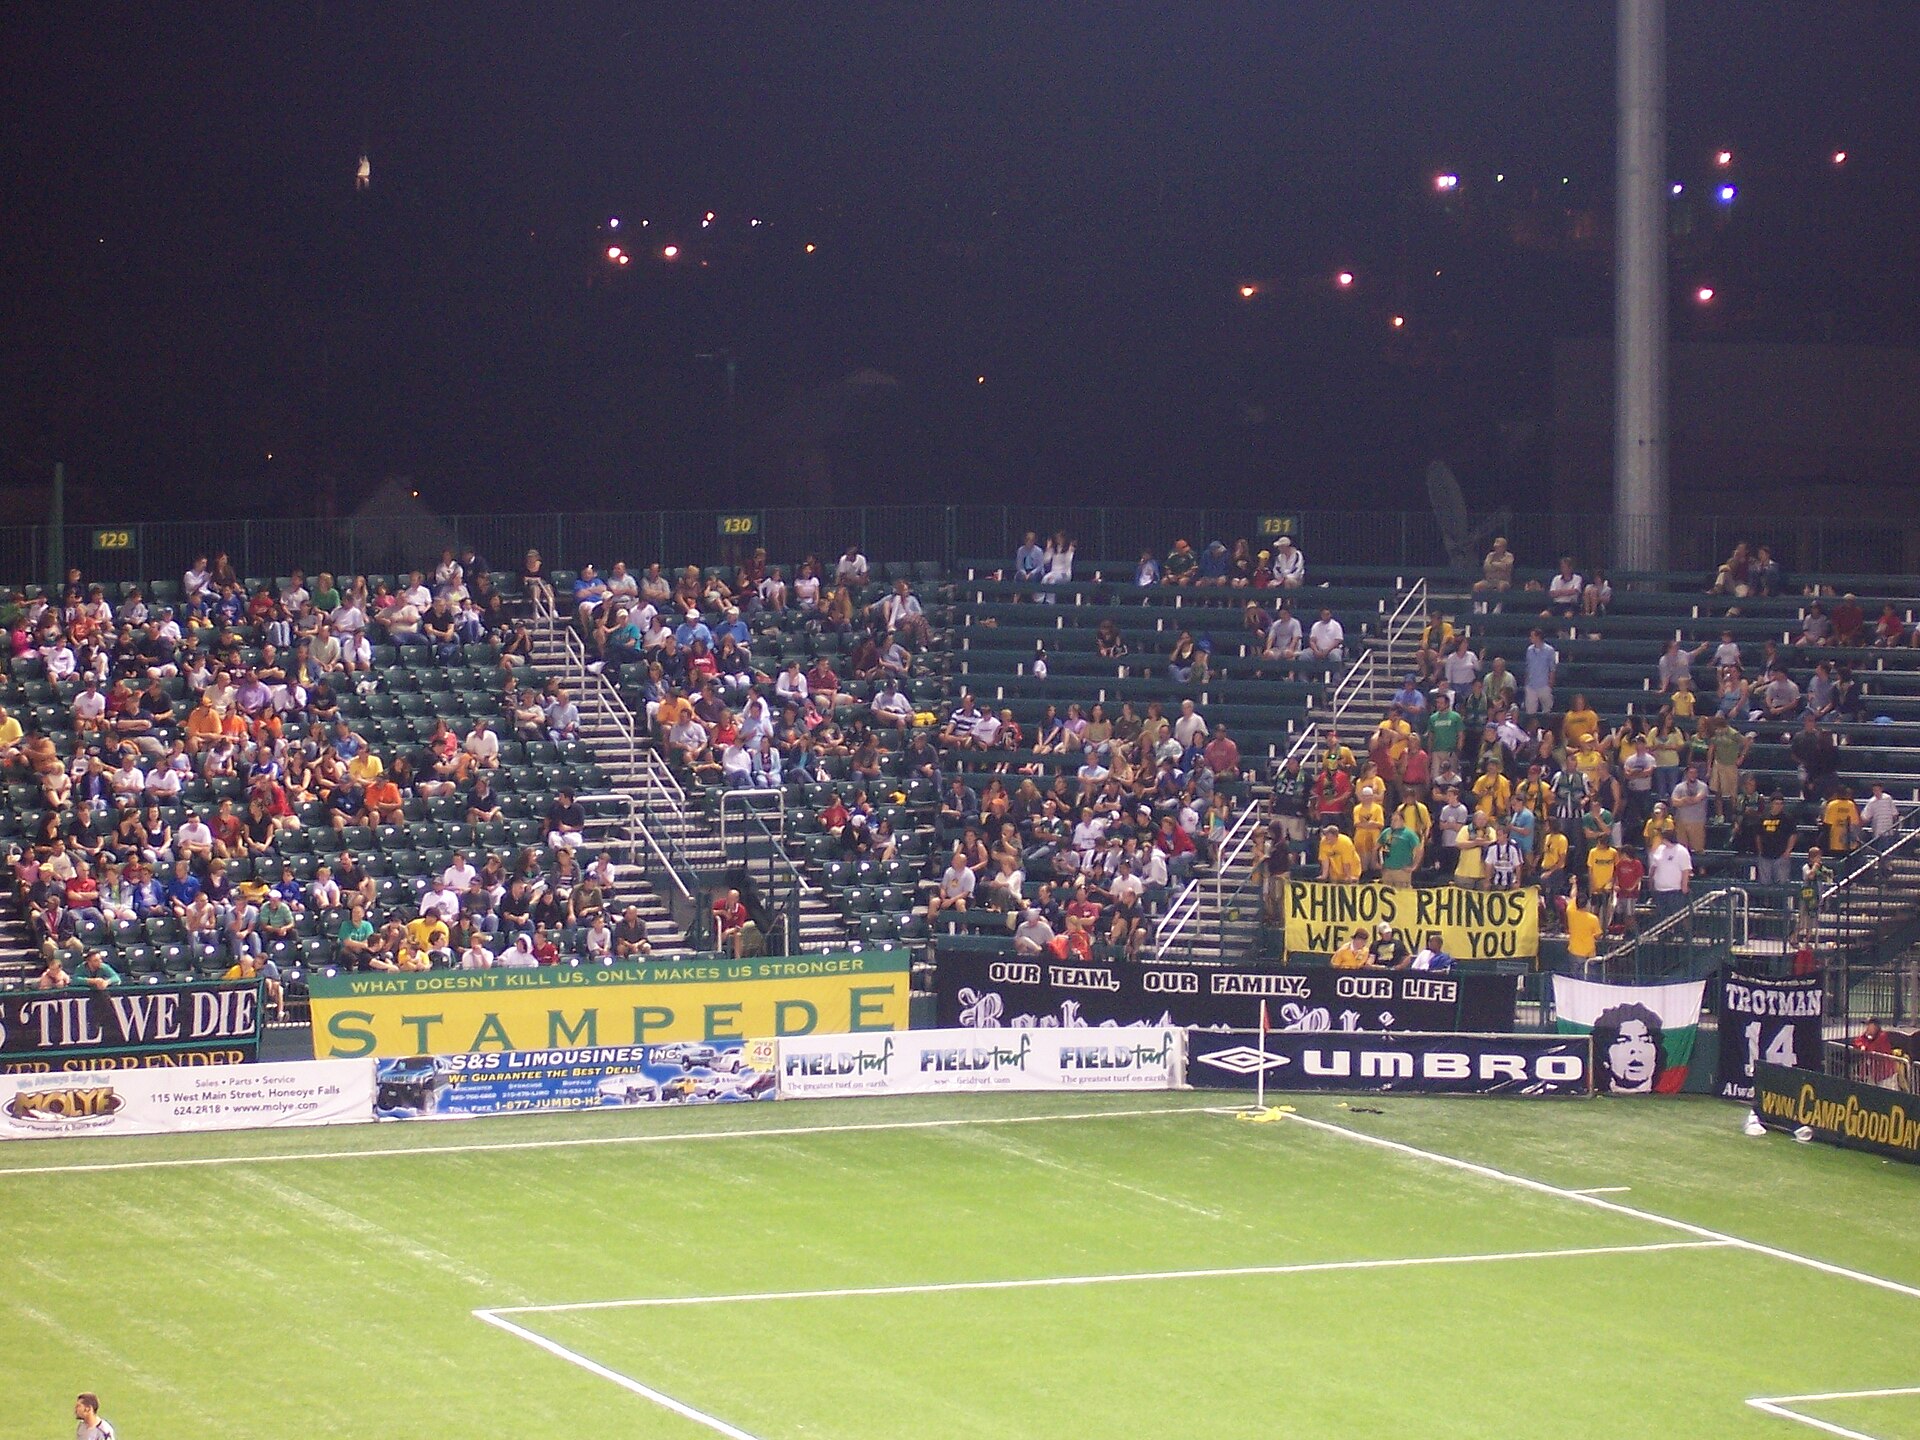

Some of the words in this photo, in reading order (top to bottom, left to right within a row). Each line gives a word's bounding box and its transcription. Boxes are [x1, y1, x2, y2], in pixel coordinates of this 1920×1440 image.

[723, 518, 753, 533] 130
[1264, 519, 1291, 533] 131
[98, 532, 129, 548] 129
[1290, 883, 1397, 922] RHINOS
[1416, 887, 1526, 927] RHINOS
[1306, 924, 1349, 952] WE
[1466, 929, 1517, 958] YOU
[351, 980, 408, 993] WHAT
[415, 974, 498, 990] DOESN'T
[506, 972, 551, 986] KILL
[557, 971, 590, 985] US,
[596, 969, 647, 982] ONLY
[654, 967, 719, 980] MAKES
[728, 965, 752, 978] US
[760, 959, 864, 976] STRONGER
[989, 962, 1041, 984] OUR
[1049, 965, 1121, 992] TEAM,
[1143, 972, 1199, 993] OUR
[1211, 973, 1311, 999] FAMILY,
[1337, 976, 1393, 999] OUR
[1402, 979, 1458, 1002] LIFE
[1726, 983, 1822, 1016] TROTMAN
[110, 993, 182, 1043] WE
[190, 988, 259, 1038] DIE
[327, 984, 895, 1058] STAMPEDE
[451, 1053, 500, 1070] S&S
[509, 1047, 644, 1068] LIMOUSINES
[753, 1046, 772, 1056] 40
[1744, 1021, 1797, 1077] 14
[448, 1074, 468, 1083] WE
[471, 1070, 542, 1082] GUARANTEE
[546, 1069, 568, 1078] THE
[573, 1067, 602, 1076] BEST
[606, 1064, 641, 1074] DEAL!
[1303, 1049, 1583, 1081] UMBRO
[195, 1079, 218, 1088] Sales
[229, 1077, 252, 1086] Parts
[262, 1075, 296, 1085] Service
[1061, 1075, 1077, 1083] The
[1079, 1075, 1111, 1085] greatest
[1113, 1074, 1130, 1082] turf
[151, 1093, 170, 1103] 115
[173, 1092, 199, 1102] West
[202, 1090, 227, 1101] Main
[268, 1087, 314, 1099] Honeoye
[318, 1085, 340, 1096] Falls
